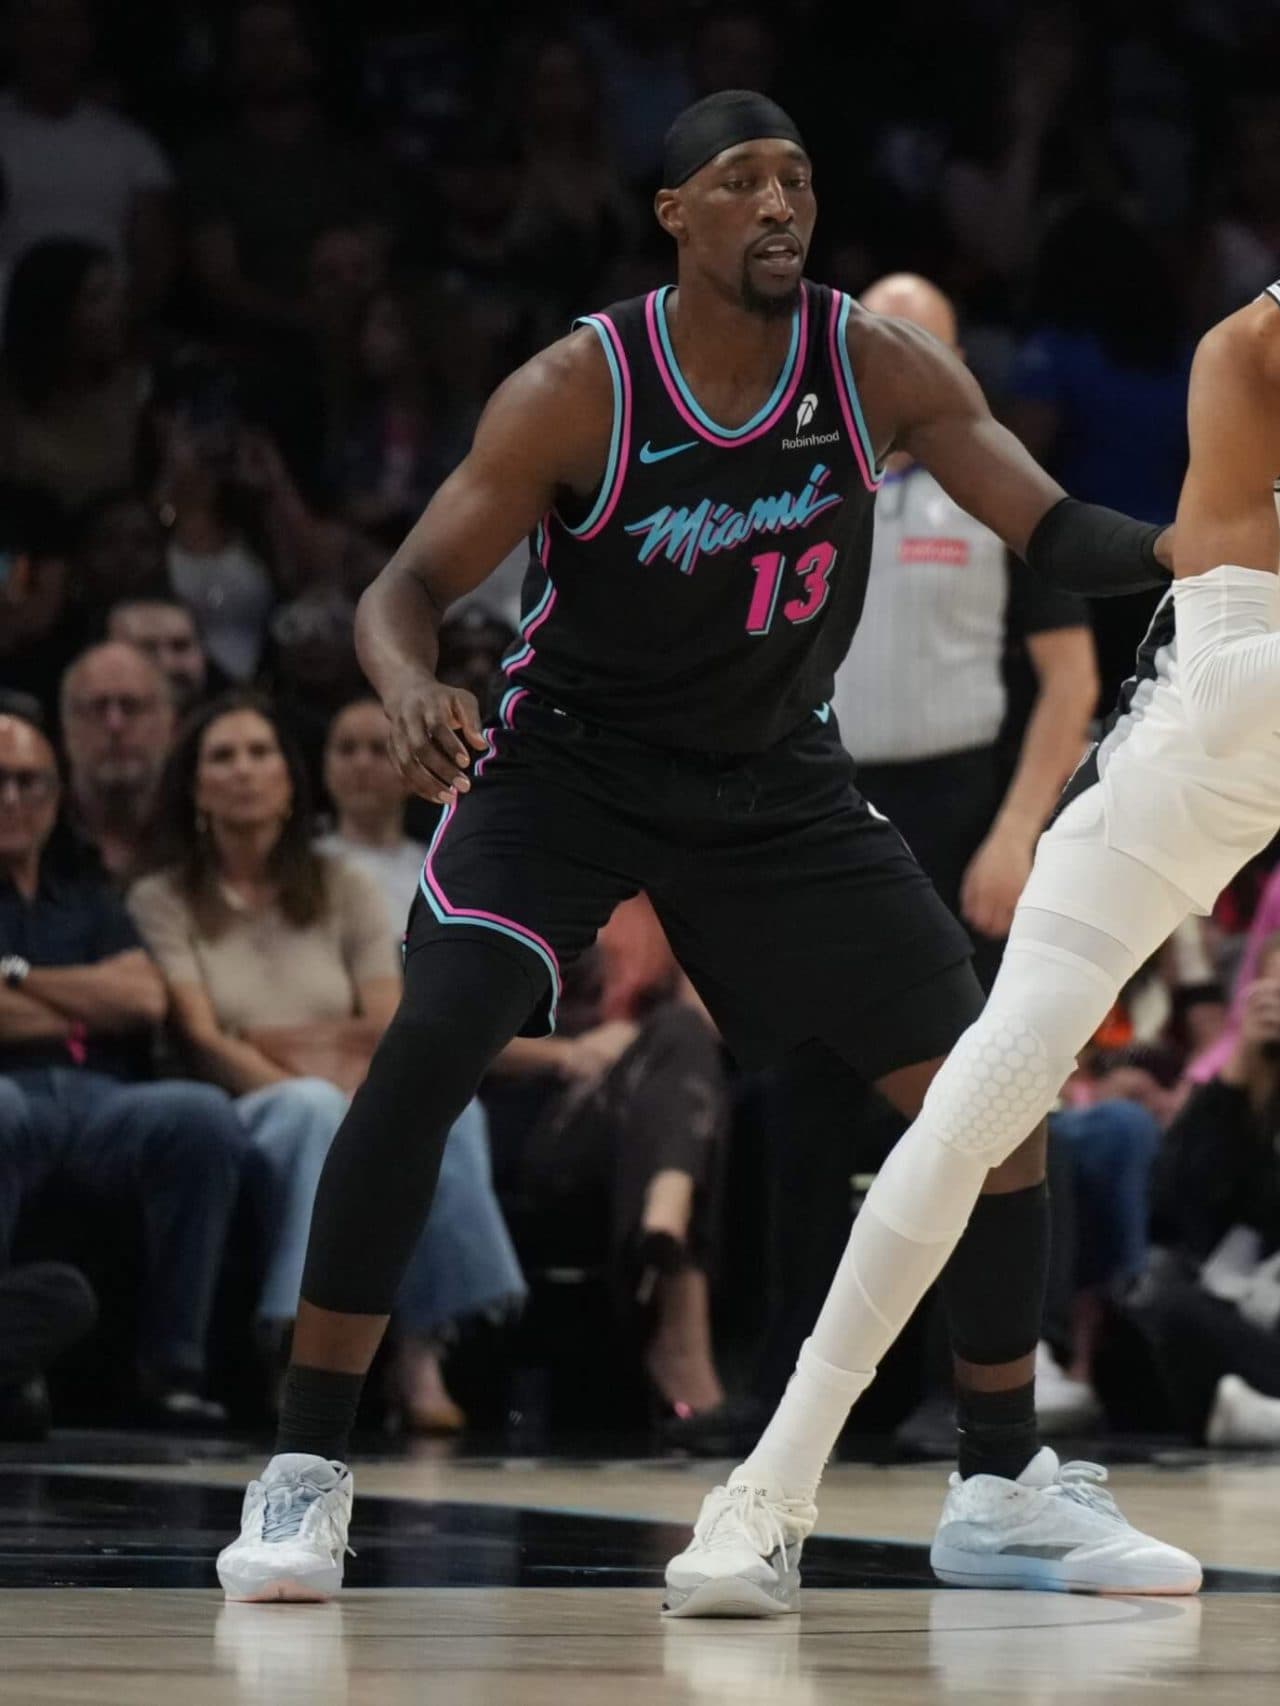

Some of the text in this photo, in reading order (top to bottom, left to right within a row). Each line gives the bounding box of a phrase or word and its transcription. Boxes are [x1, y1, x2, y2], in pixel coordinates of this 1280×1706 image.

[782, 429, 840, 450] Robinhood
[624, 463, 843, 575] Miami
[745, 541, 838, 635] 13
